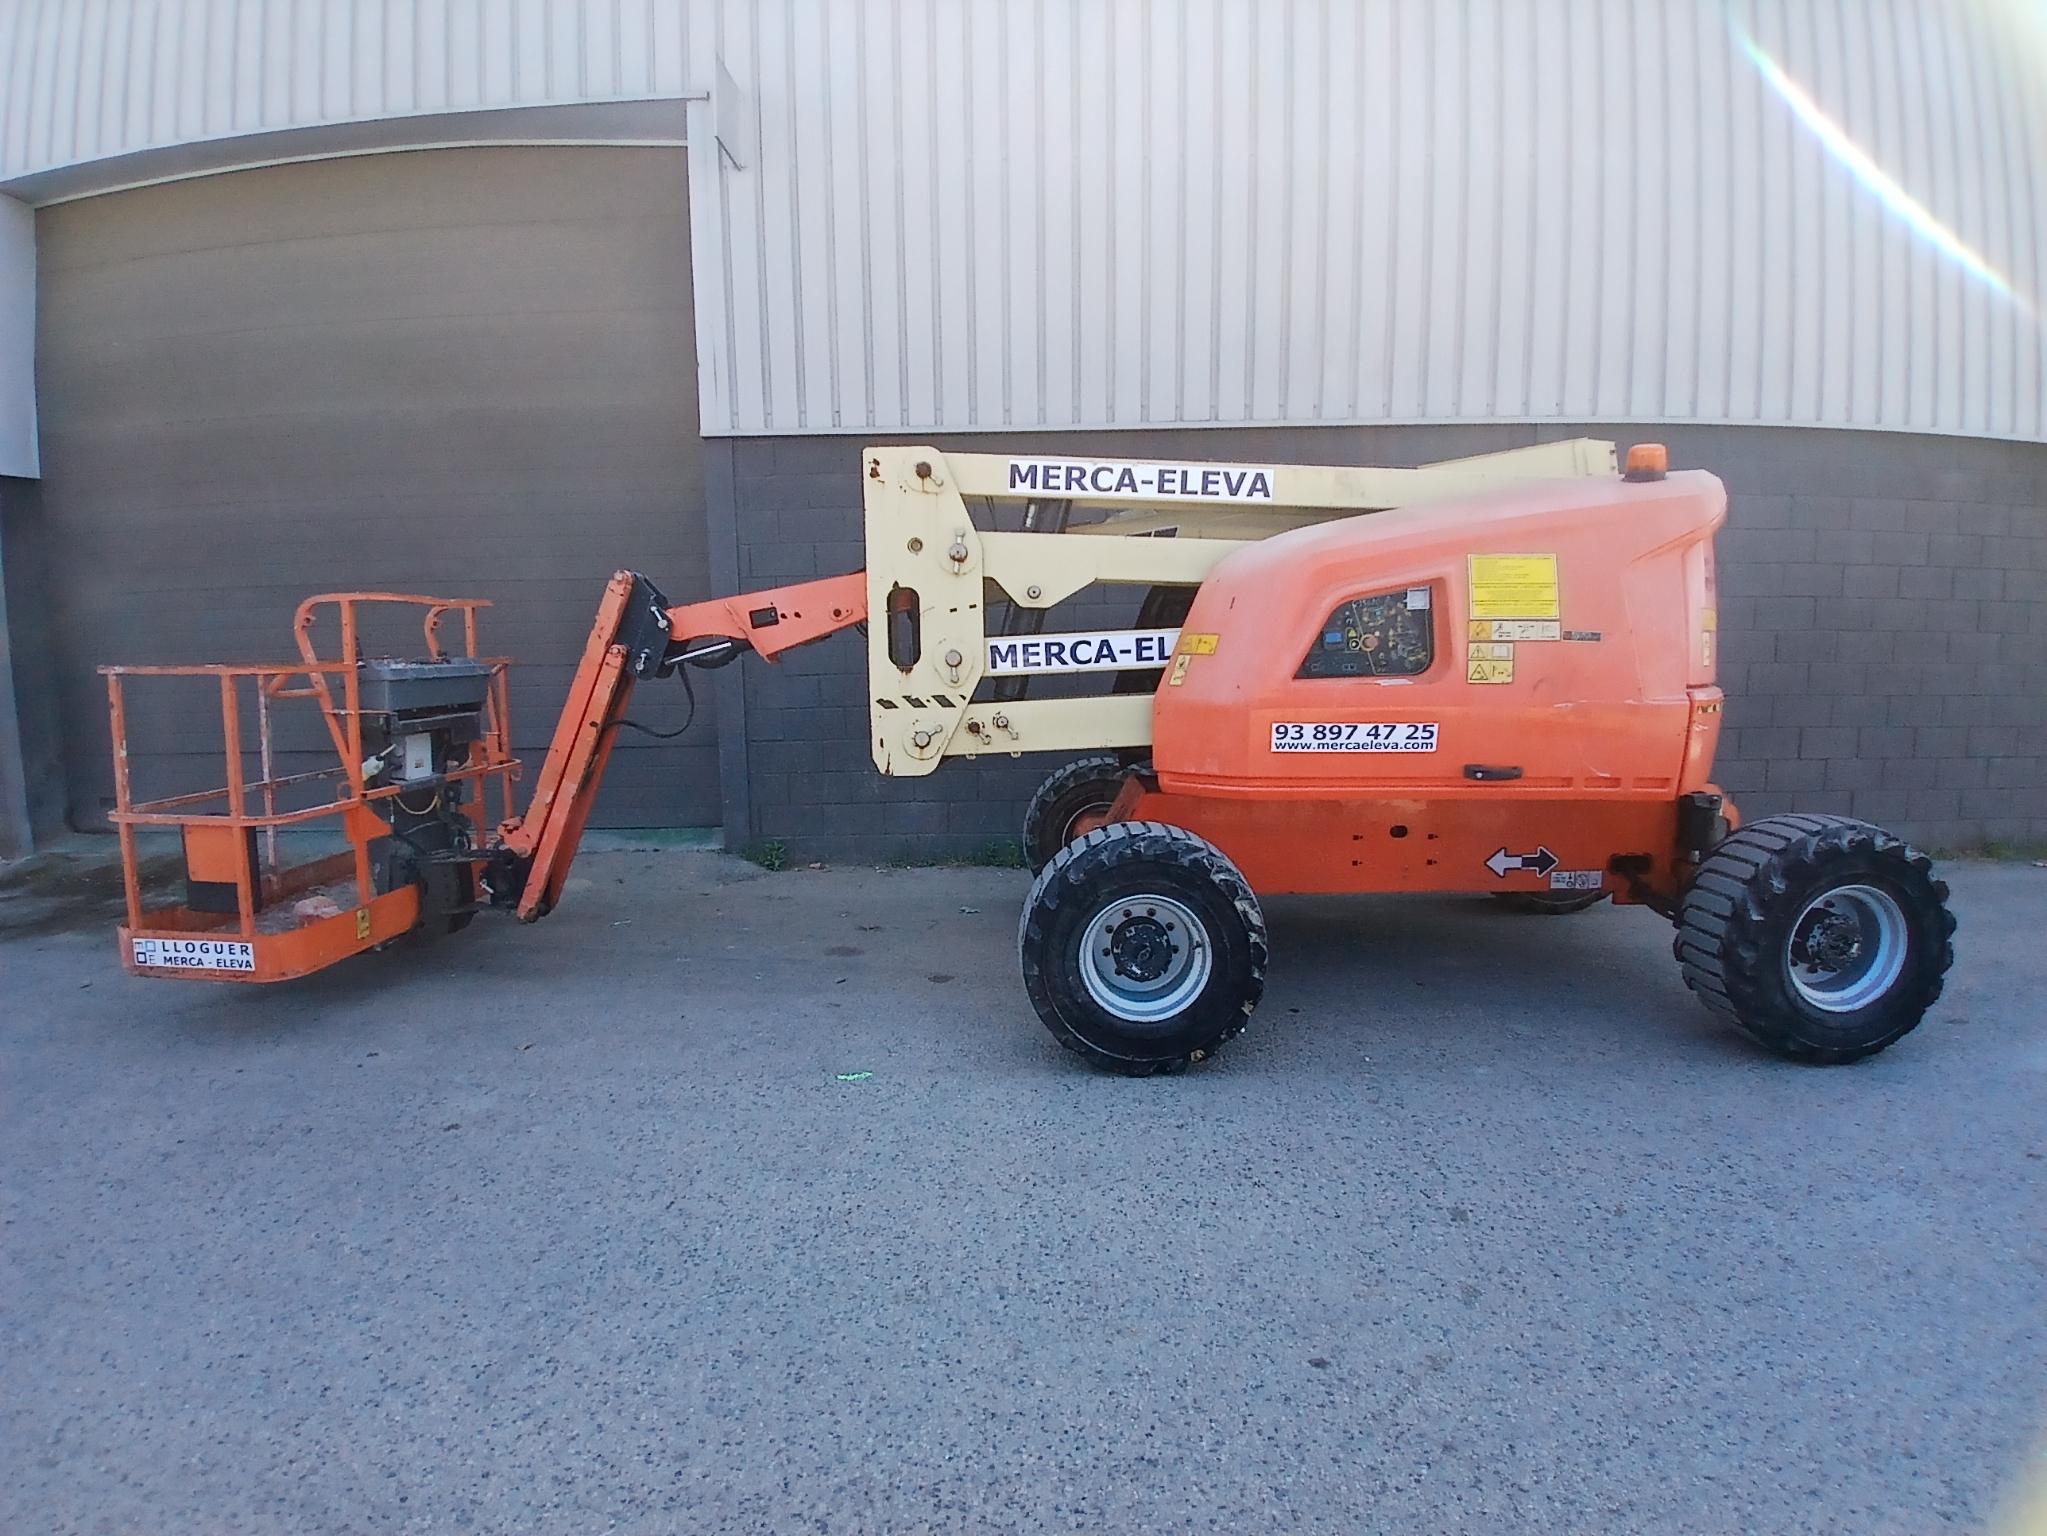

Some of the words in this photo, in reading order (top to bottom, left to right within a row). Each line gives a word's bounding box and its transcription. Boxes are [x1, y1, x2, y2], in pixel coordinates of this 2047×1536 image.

[1009, 463, 1271, 498] MERCA-ELEVA
[1275, 724, 1304, 740] 93
[1313, 724, 1359, 741] 897
[1366, 724, 1397, 740] 47
[1405, 724, 1435, 740] 25
[1275, 740, 1434, 750] www.mercaeleva.com
[162, 941, 250, 956] LLOGUER
[163, 956, 204, 967] MERCA
[216, 958, 253, 969] ELEVA
